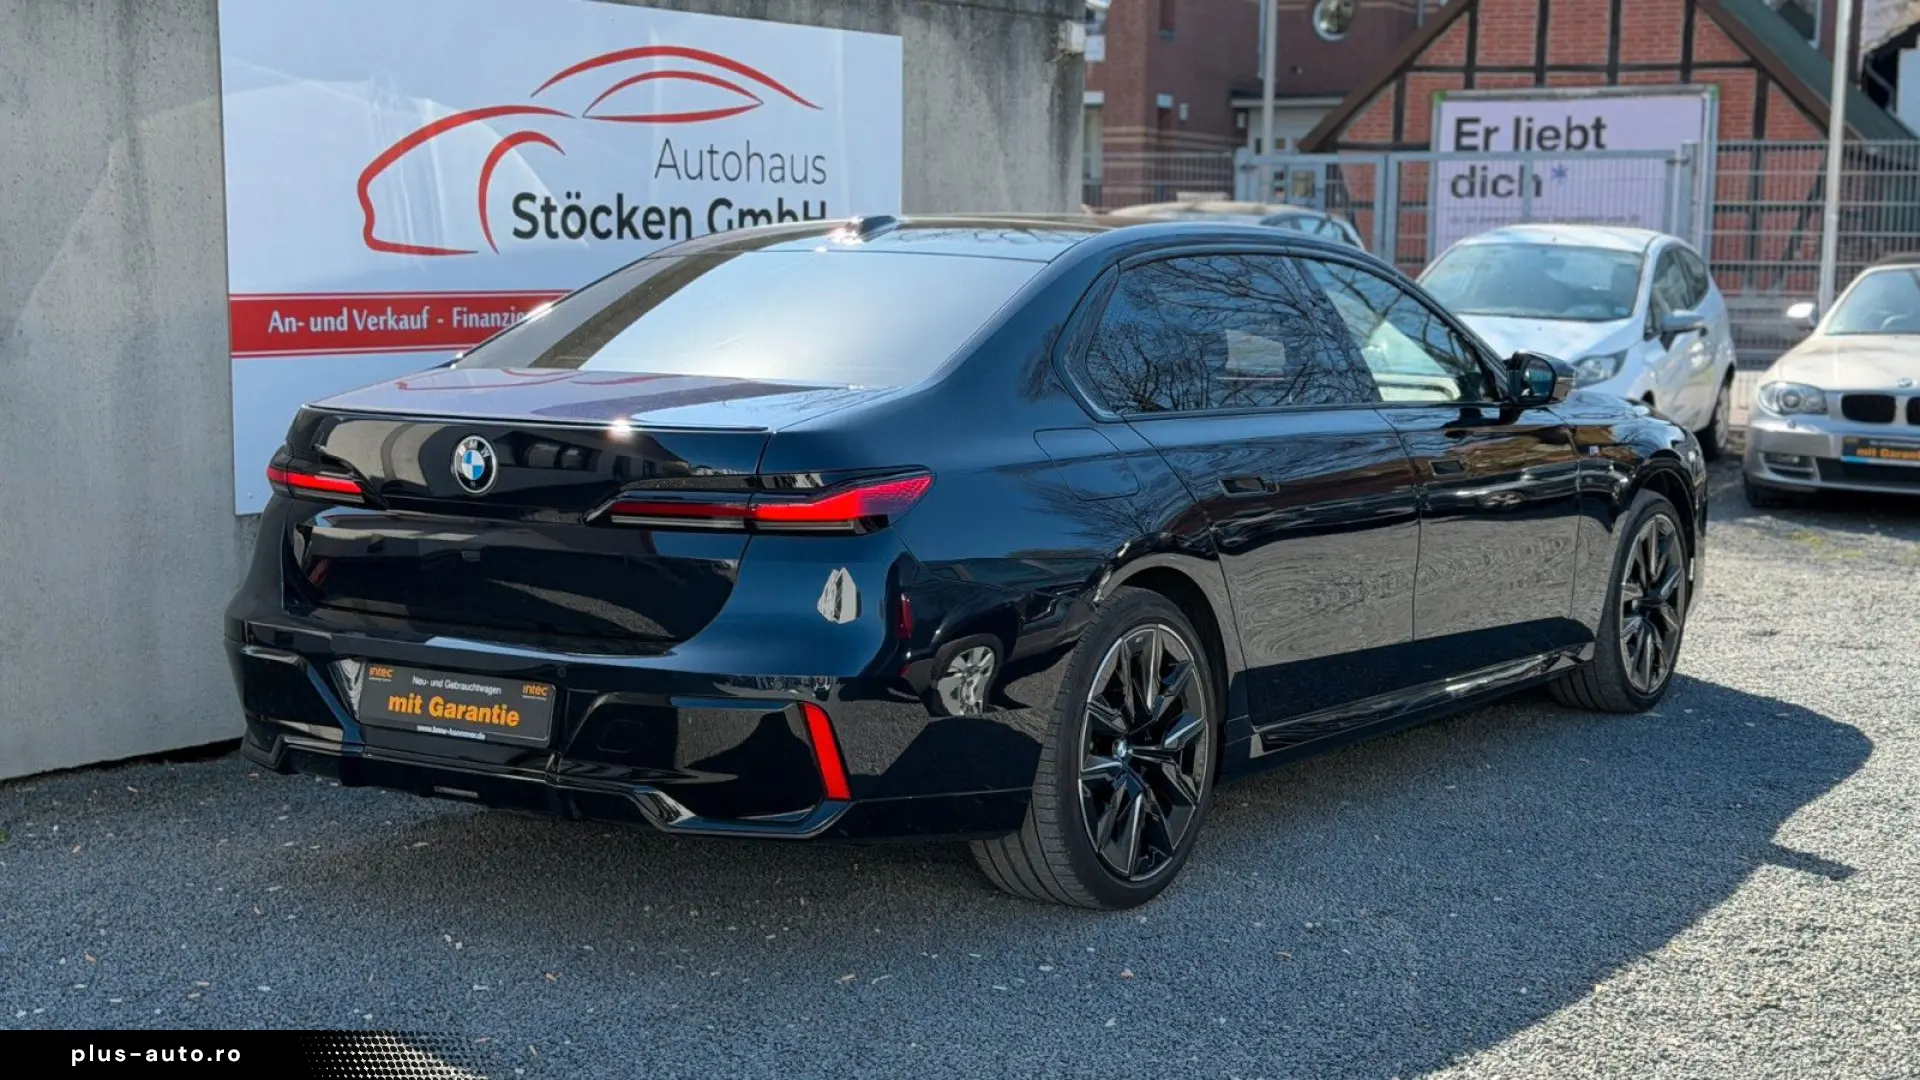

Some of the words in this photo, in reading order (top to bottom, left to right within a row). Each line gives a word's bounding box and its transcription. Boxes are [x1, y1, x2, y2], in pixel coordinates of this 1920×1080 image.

[1454, 116, 1499, 151] Er
[1513, 115, 1606, 151] liebt
[653, 137, 828, 185] Autohaus
[512, 190, 692, 241] Stöcken
[268, 309, 306, 334] An-
[309, 306, 348, 333] und
[352, 305, 431, 331] Verkauf
[411, 675, 429, 687] Neu-
[430, 677, 444, 688] und
[444, 679, 502, 695] Gebrauchtwagen
[388, 692, 423, 715] mit
[428, 695, 520, 727] Garantie
